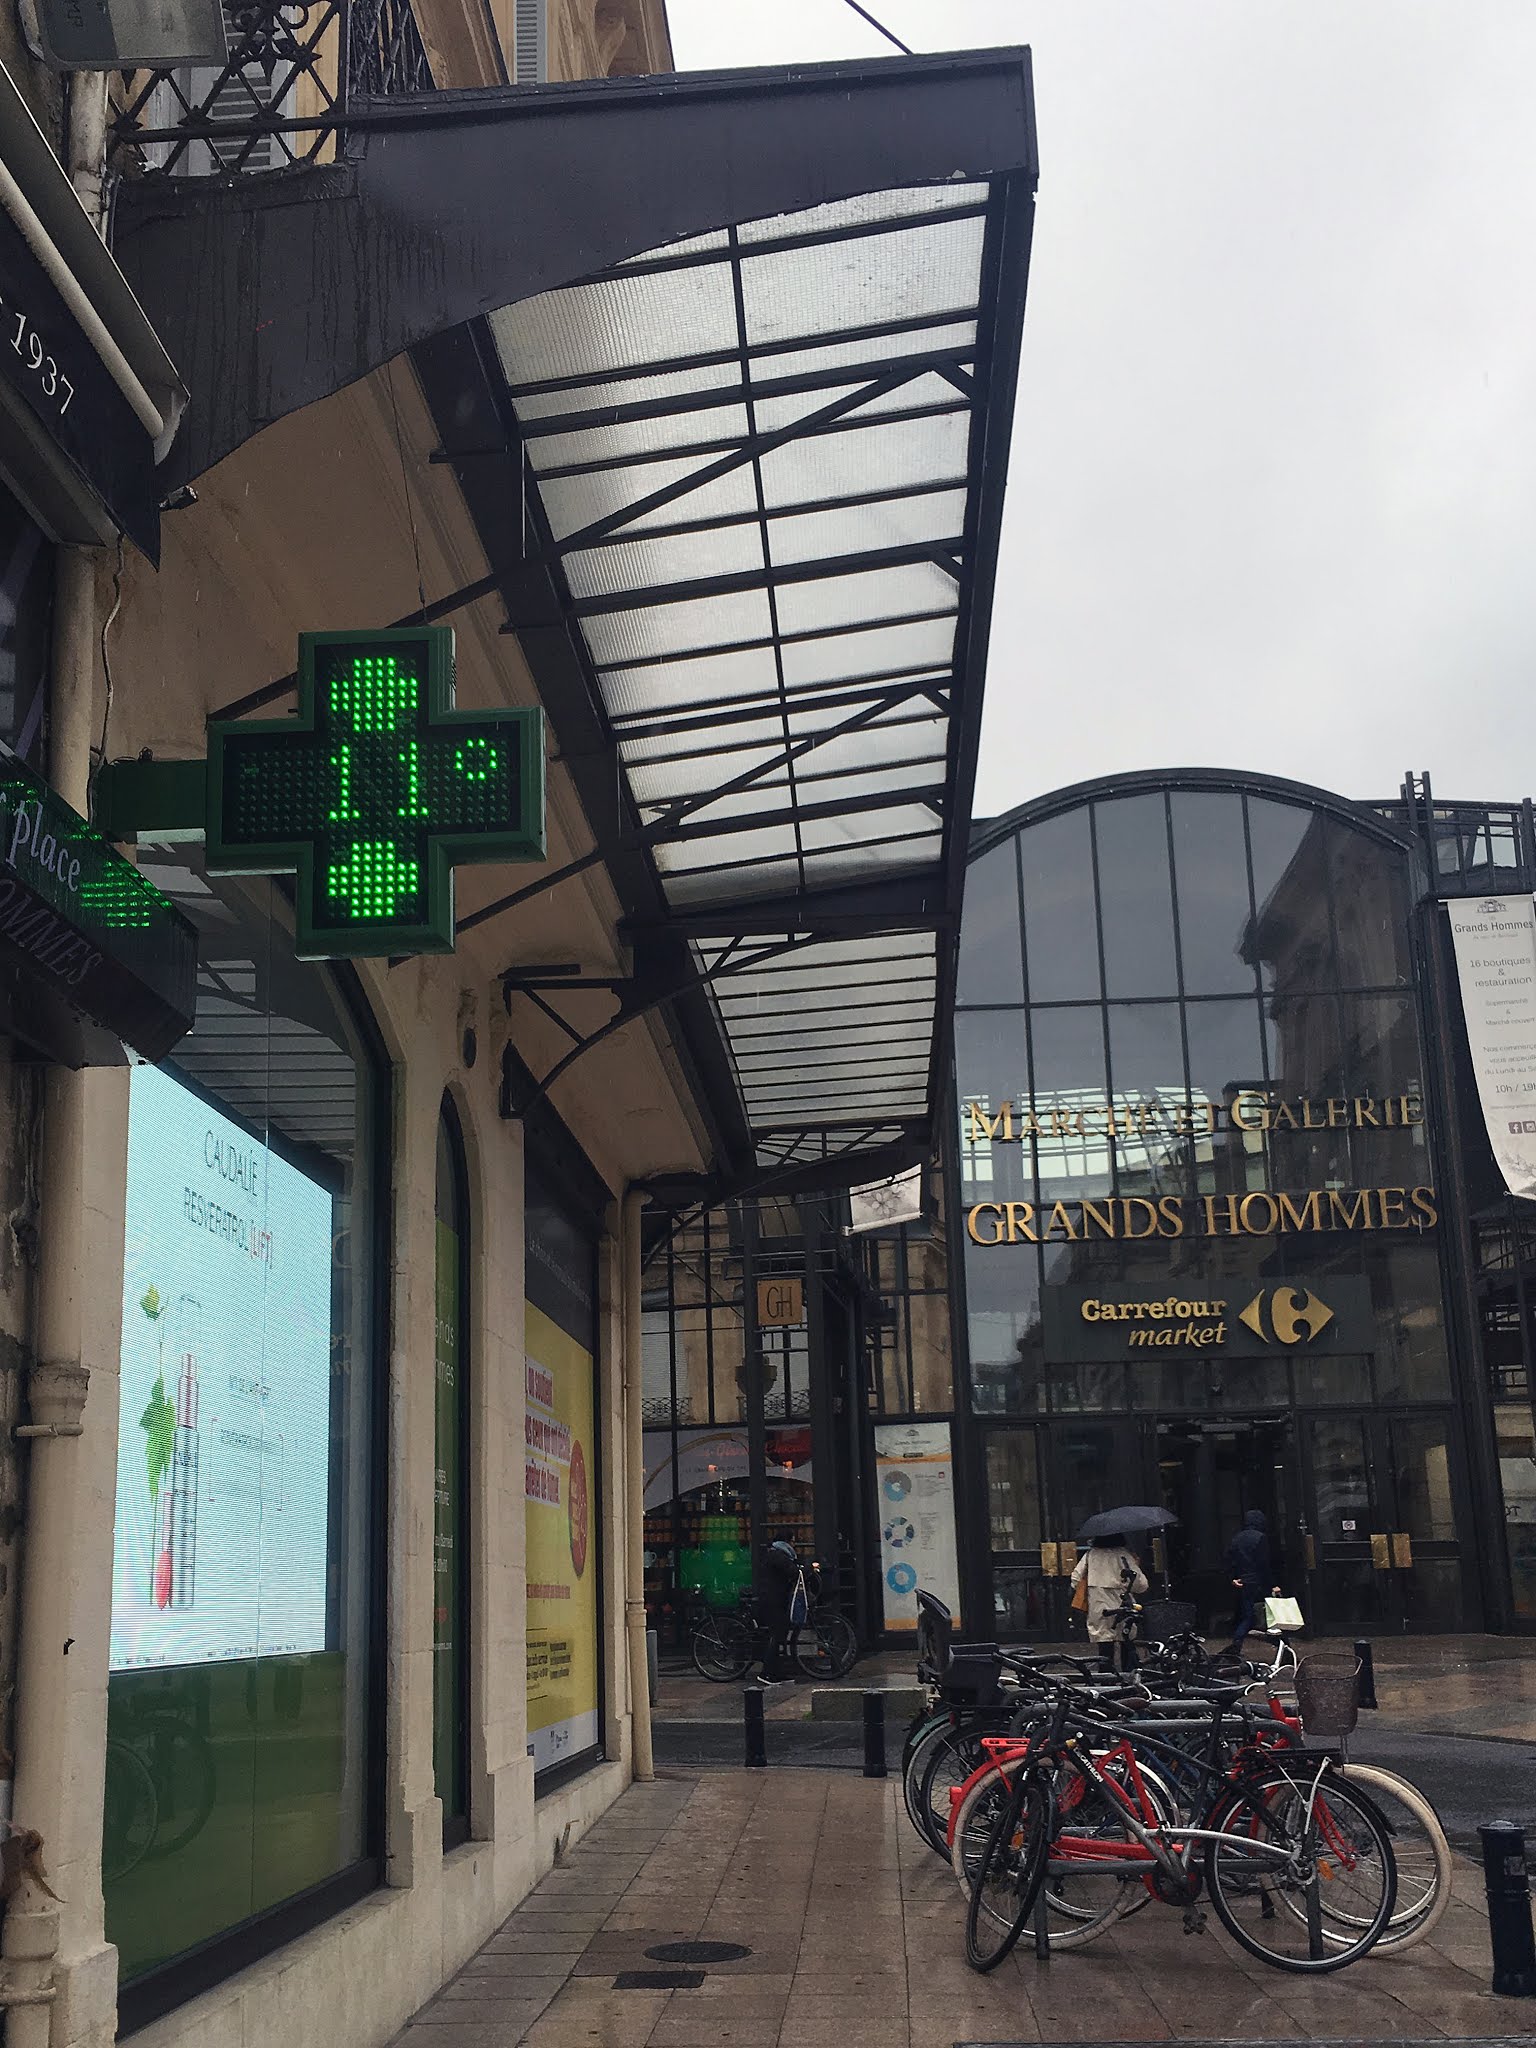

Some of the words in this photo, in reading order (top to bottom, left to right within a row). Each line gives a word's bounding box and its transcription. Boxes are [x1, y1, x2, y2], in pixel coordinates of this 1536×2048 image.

[10, 311, 75, 415] 1937
[5, 799, 81, 893] Place
[1454, 923, 1489, 933] Grands
[1491, 920, 1534, 931] Hommes
[1470, 959, 1482, 968] 16
[1483, 957, 1531, 968] boutiques
[1475, 976, 1533, 988] restauration
[1495, 1083, 1513, 1095] 10h
[1231, 1090, 1426, 1132] GALERIE
[966, 1195, 1185, 1245] GRANDS
[1203, 1186, 1438, 1236] HOMMES
[766, 1286, 793, 1319] GH
[1081, 1297, 1227, 1322] Carrefour
[1128, 1321, 1228, 1348] market
